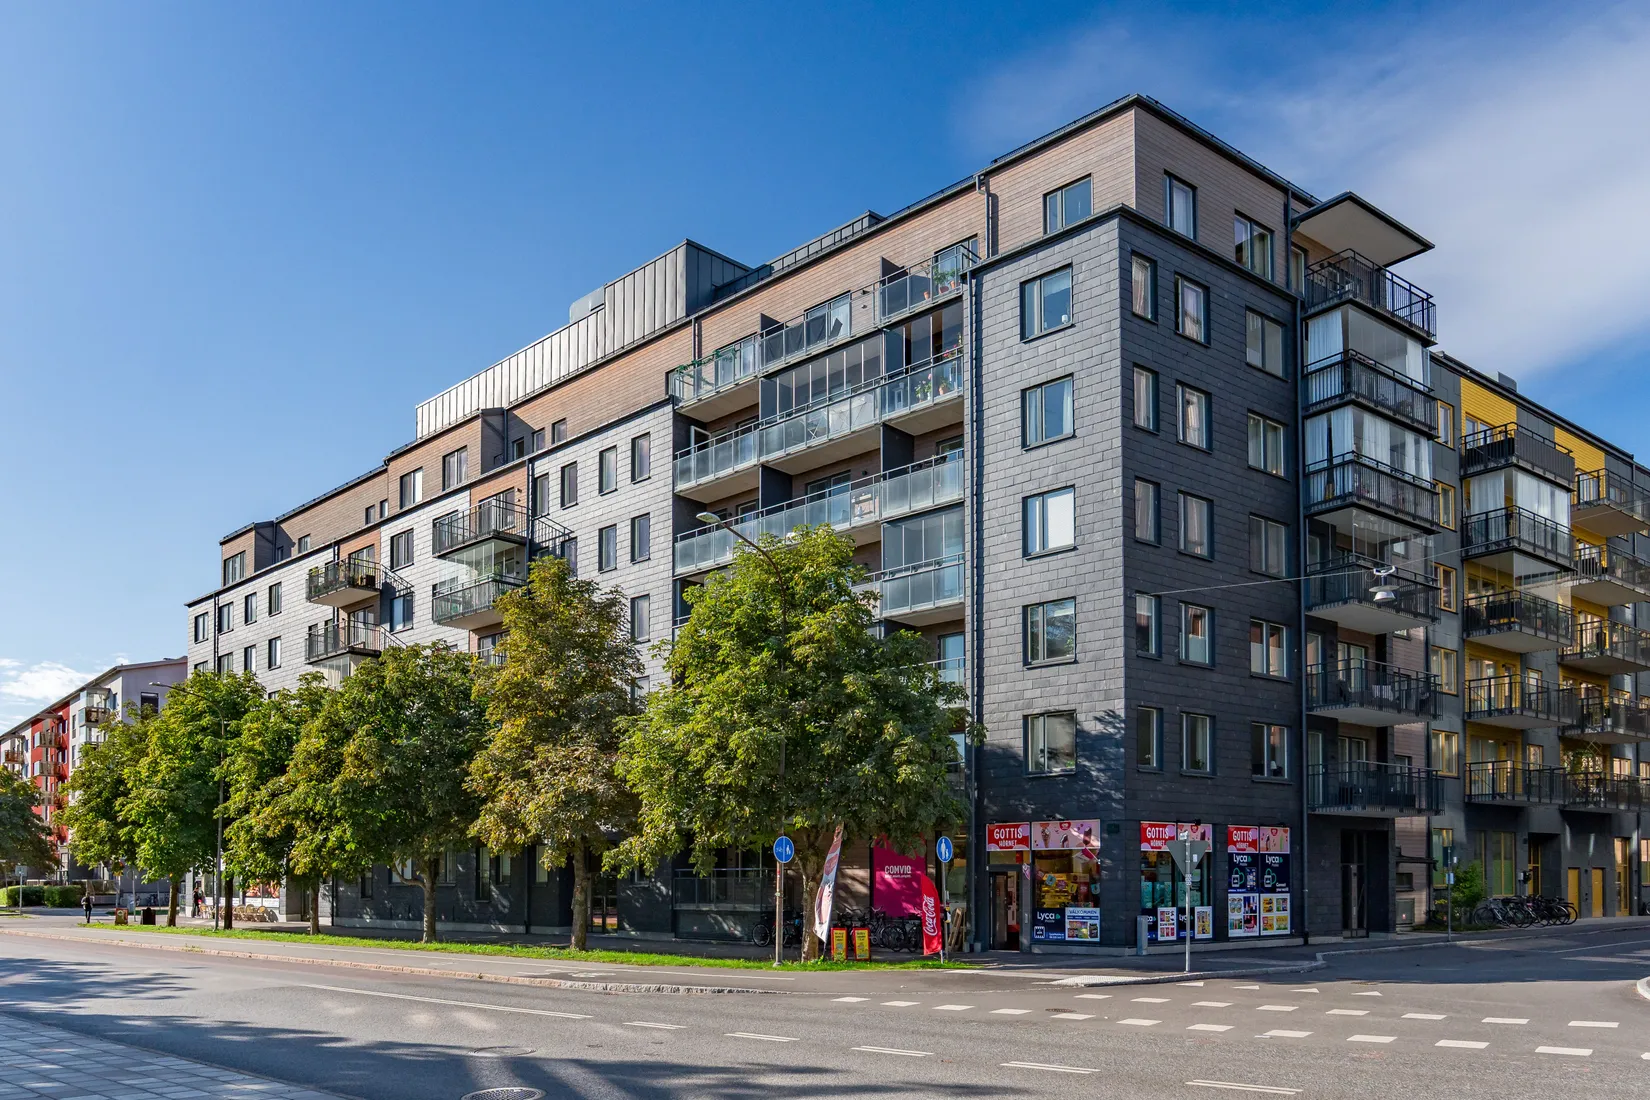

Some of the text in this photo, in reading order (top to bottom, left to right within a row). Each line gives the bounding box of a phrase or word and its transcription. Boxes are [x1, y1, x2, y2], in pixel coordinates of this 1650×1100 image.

[994, 828, 1022, 839] GOTTIS
[1146, 827, 1169, 839] GOTTIS
[1233, 830, 1252, 842] GOTTIS
[1234, 854, 1248, 864] Lyca
[1266, 855, 1280, 865] Lyca
[885, 866, 912, 874] COMVIQ
[1037, 912, 1054, 920] Lyca
